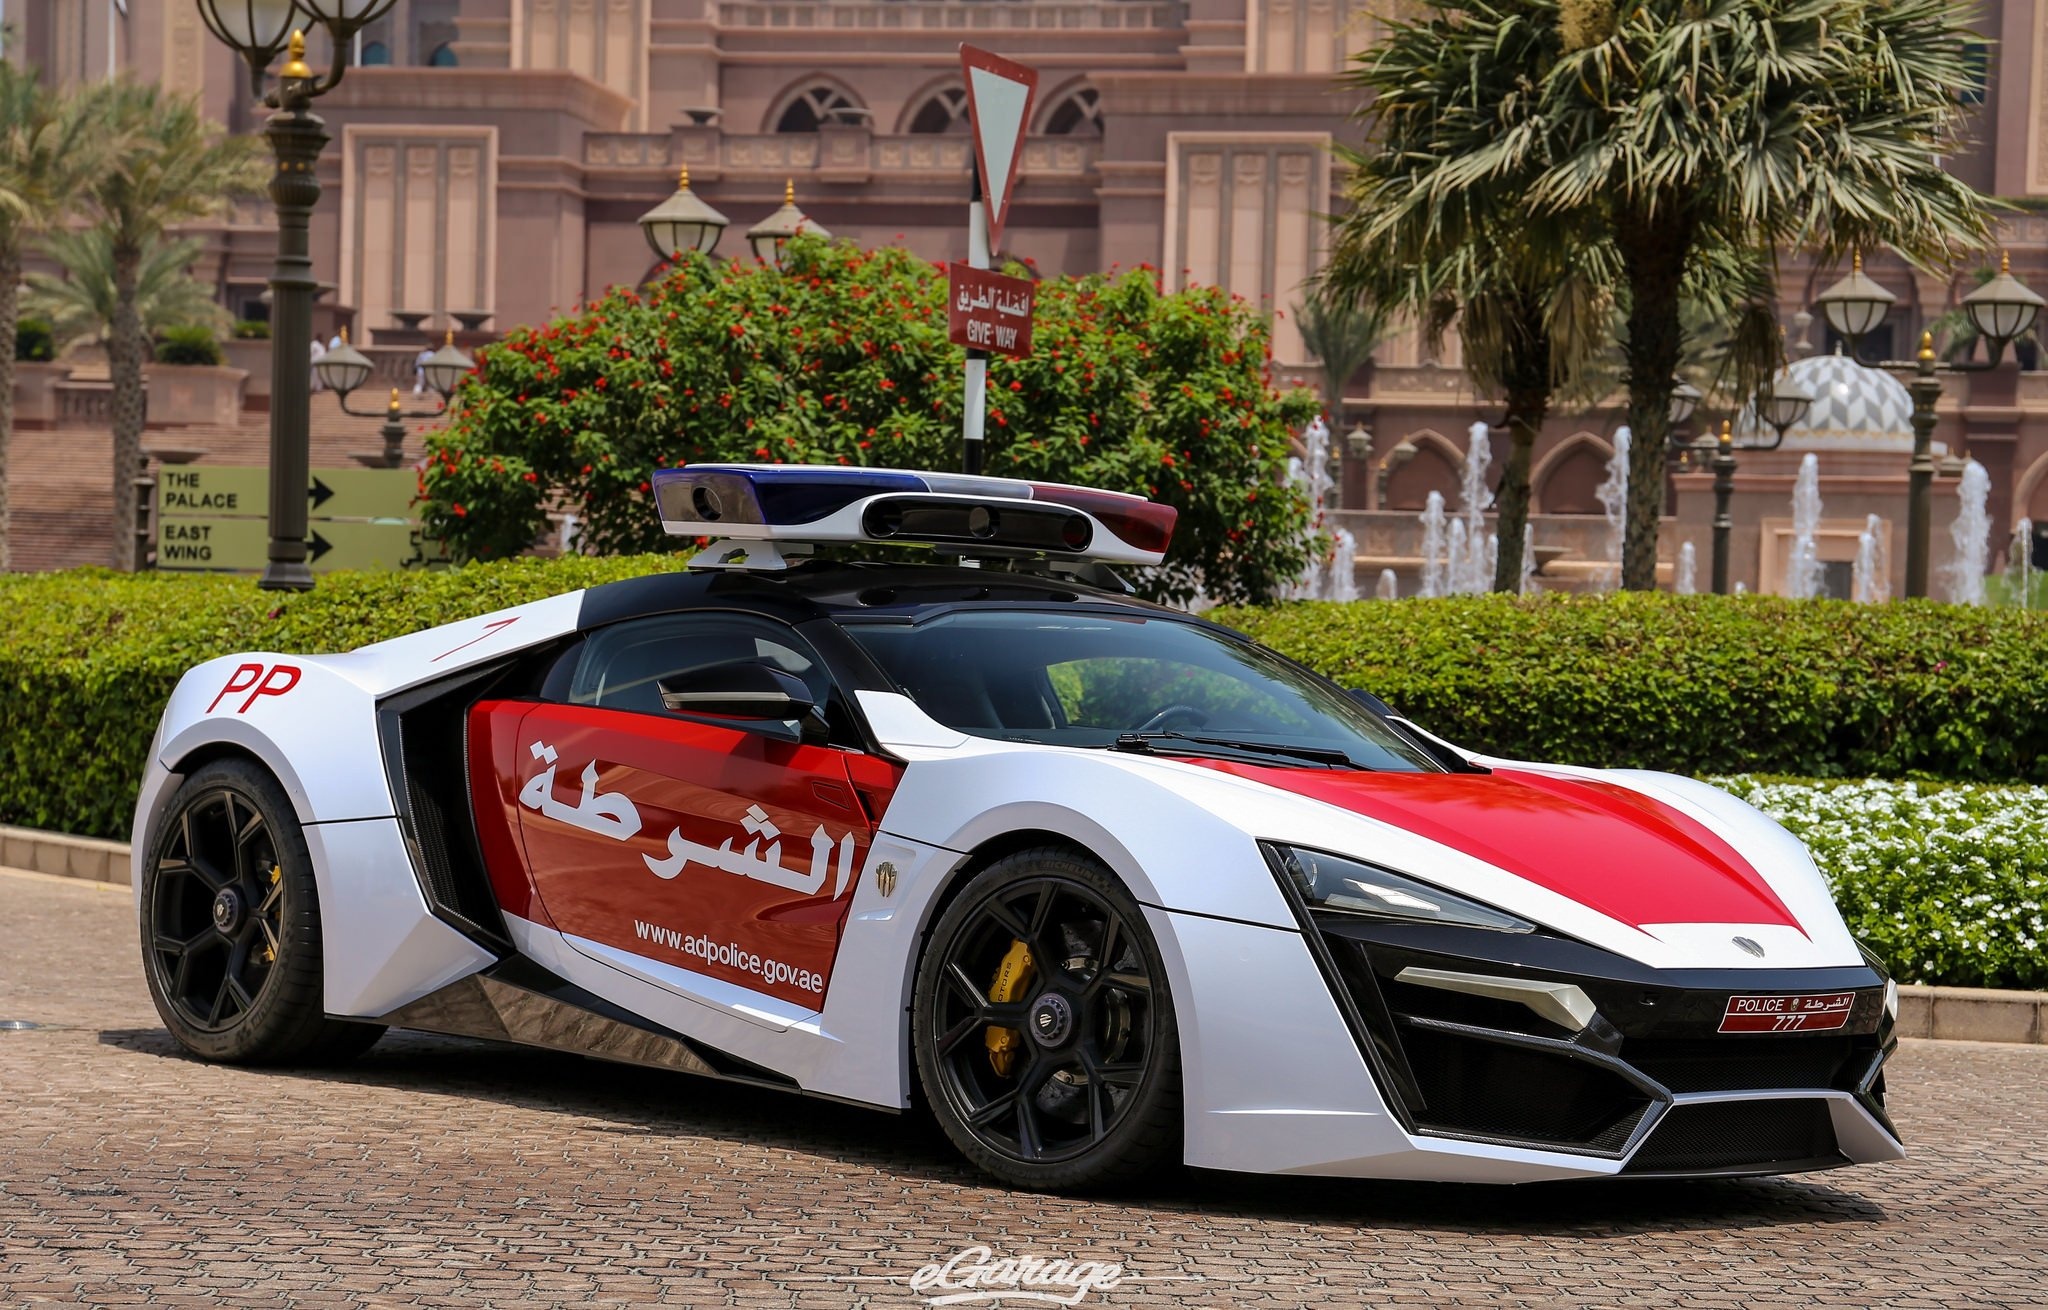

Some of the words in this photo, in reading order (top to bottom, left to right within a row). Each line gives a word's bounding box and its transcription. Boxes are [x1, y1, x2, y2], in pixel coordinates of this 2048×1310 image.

[957, 284, 995, 312] الطريق
[967, 319, 991, 345] GIVE
[995, 325, 1018, 349] WAY
[166, 472, 200, 488] THE
[165, 492, 238, 509] PALACE
[164, 525, 212, 541] EAST
[164, 545, 212, 560] WING
[205, 663, 302, 714] PP
[519, 740, 855, 901] الشرطة
[634, 919, 823, 994] www.adpolice.gov.ae
[998, 961, 1011, 1002] OTORS
[1736, 999, 1785, 1012] POLICE
[1804, 997, 1850, 1011] الشرطة
[1772, 1015, 1807, 1031] 777
